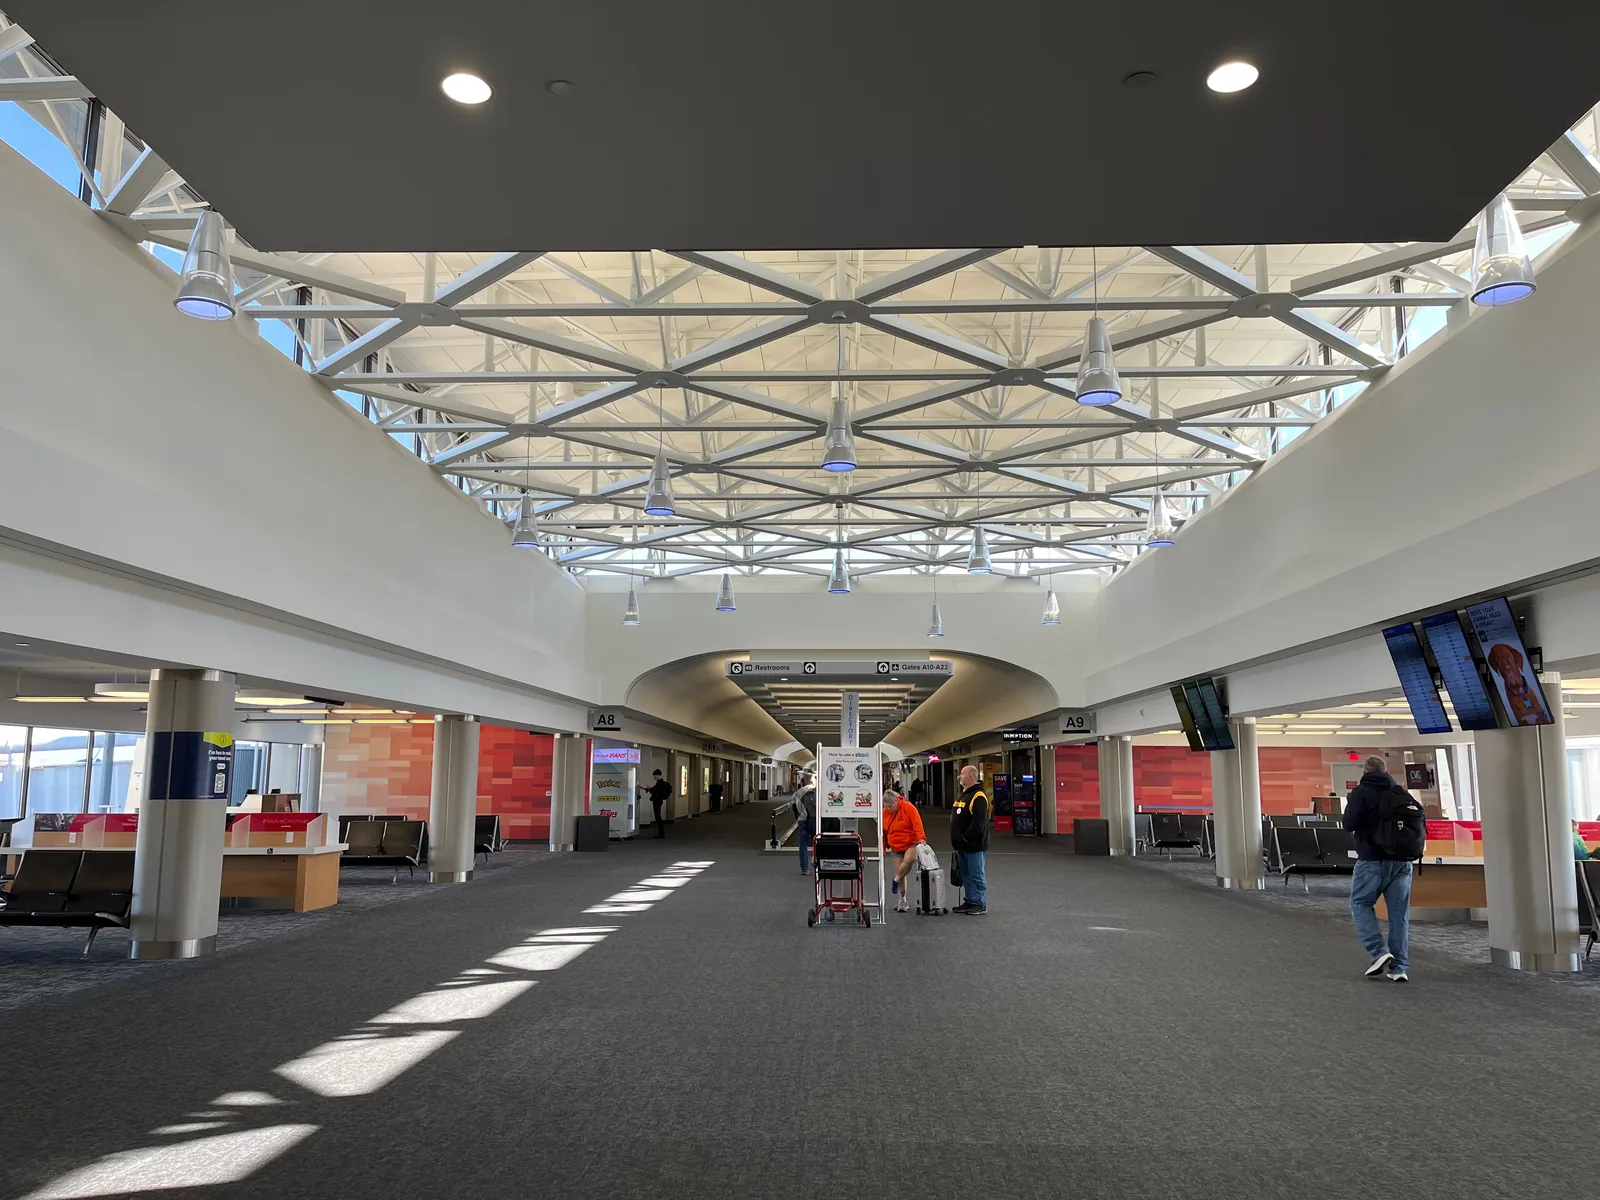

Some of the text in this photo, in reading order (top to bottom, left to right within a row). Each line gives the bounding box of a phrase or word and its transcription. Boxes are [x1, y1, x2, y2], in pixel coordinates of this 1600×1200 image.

[1470, 606, 1494, 617] DOES YOUR
[597, 714, 615, 725] A8
[1066, 716, 1084, 728] A9
